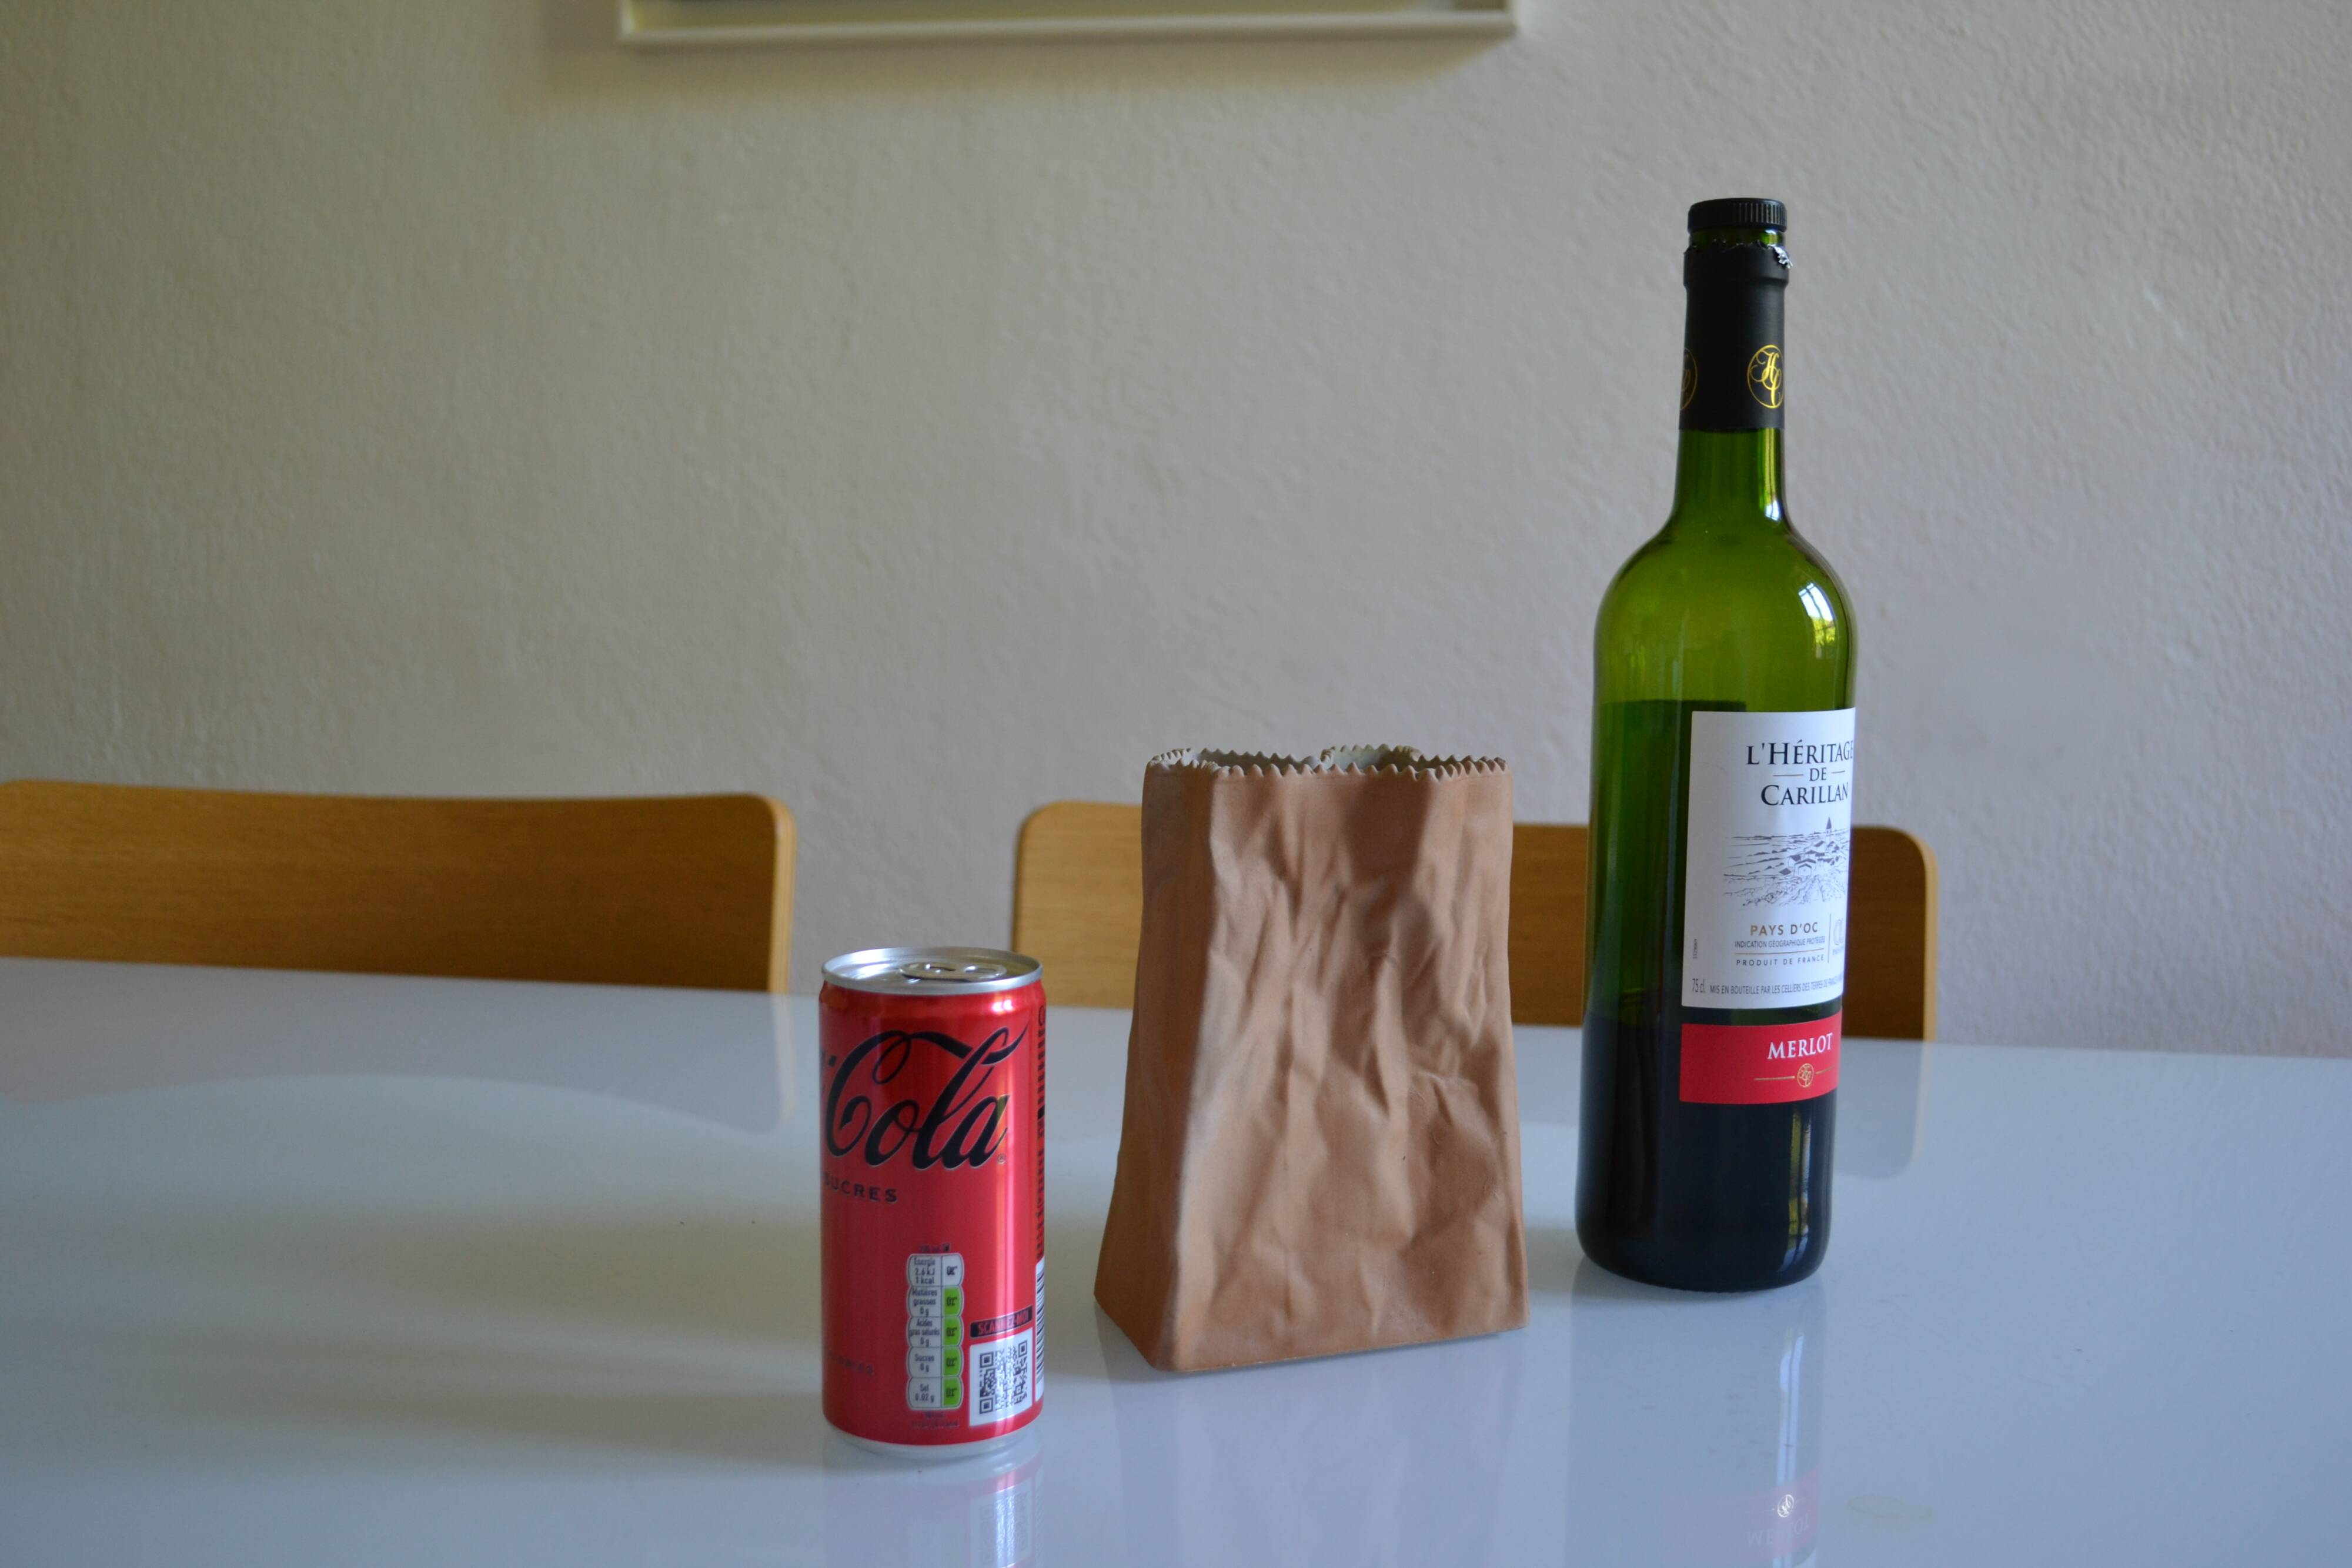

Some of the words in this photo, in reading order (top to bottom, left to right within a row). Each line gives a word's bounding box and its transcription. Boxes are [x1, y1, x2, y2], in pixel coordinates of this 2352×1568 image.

[1746, 739, 1853, 765] L'HÉRITAGE
[1809, 767, 1827, 781] DE
[1761, 782, 1849, 805] CARILLAN
[1750, 924, 1784, 936] PAYS
[1790, 922, 1818, 935] D'OC
[1768, 938, 1806, 947] GÉOGRAPHIQUE
[1798, 954, 1824, 964] FRANCE
[1692, 978, 1699, 992] 75
[1710, 985, 1720, 994] MIS
[1721, 985, 1729, 994] EN
[1730, 985, 1759, 995] BOUTEILLE
[1760, 985, 1770, 994] PAR
[1772, 984, 1780, 994] LES
[1782, 982, 1801, 993] CELLIERS
[1767, 1032, 1833, 1059] MERLOT
[978, 1309, 1029, 1334] SCAZ-MOI
